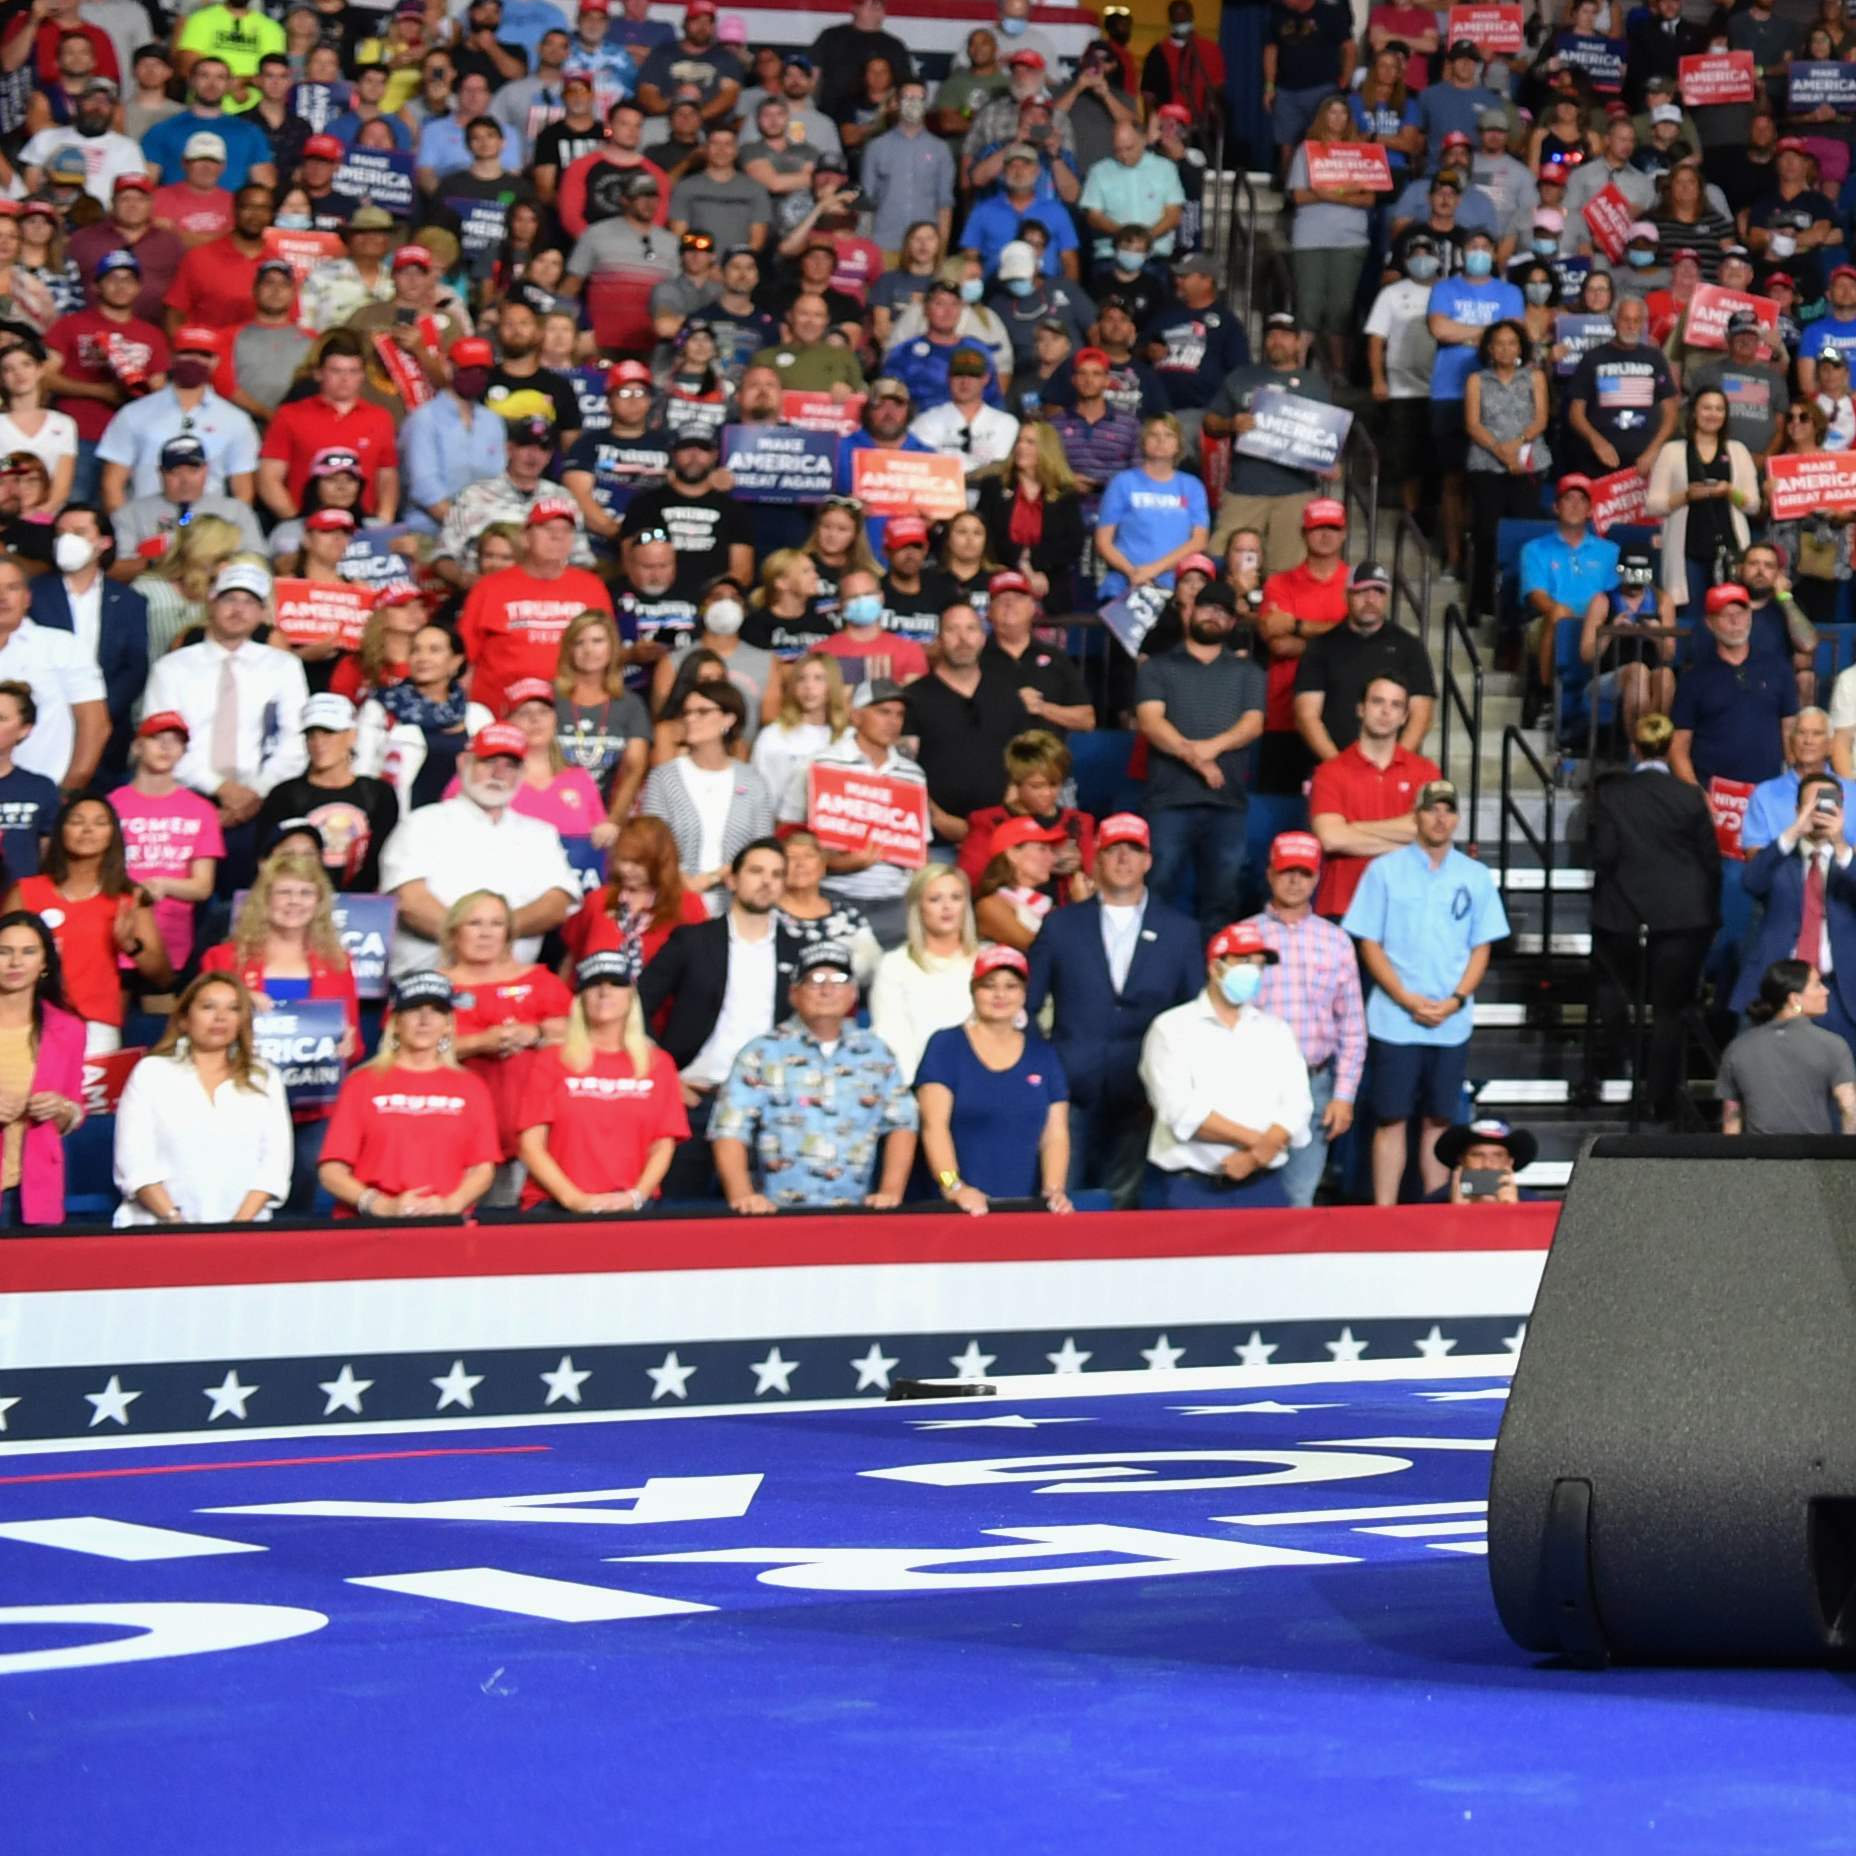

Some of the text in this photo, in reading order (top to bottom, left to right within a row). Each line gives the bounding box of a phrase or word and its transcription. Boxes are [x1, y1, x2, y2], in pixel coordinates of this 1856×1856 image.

[1453, 20, 1520, 35] AMERICA
[1684, 69, 1750, 86] AMERICA
[1313, 159, 1385, 176] AMERICA
[1596, 362, 1654, 377] TRUMP
[1254, 410, 1339, 451] AMERICA
[726, 451, 833, 475] AMERICA
[1796, 461, 1837, 475] MAKE
[860, 471, 960, 492] AMERICA
[1778, 492, 1821, 506] GREAT
[815, 791, 922, 835] AMERICA
[279, 1065, 340, 1087] GAIN
